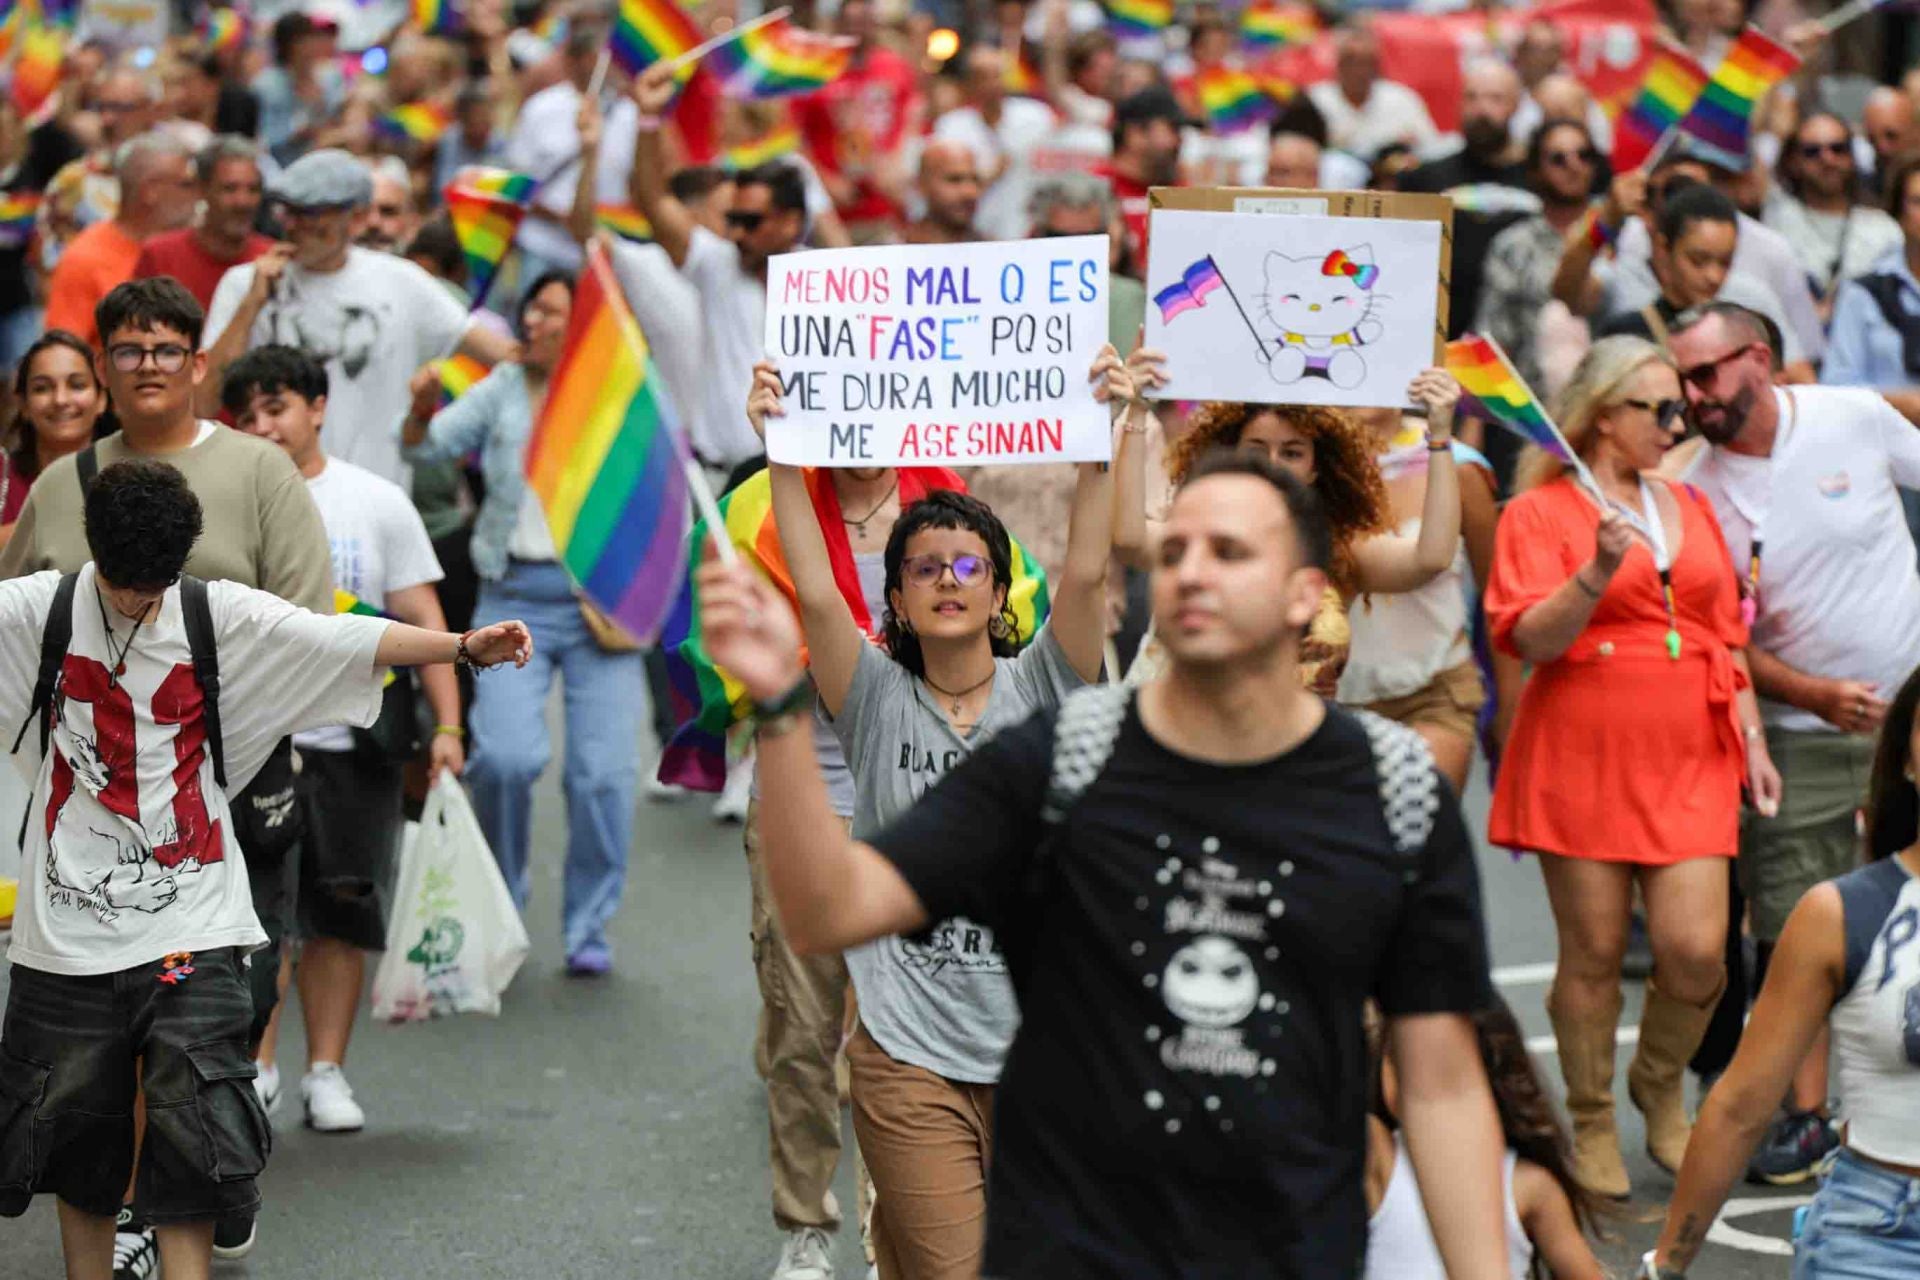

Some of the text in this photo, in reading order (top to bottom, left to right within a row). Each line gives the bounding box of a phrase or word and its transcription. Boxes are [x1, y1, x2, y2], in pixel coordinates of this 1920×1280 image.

[785, 266, 890, 304] MENOS
[906, 266, 981, 305] MAL
[1050, 260, 1098, 302] ES
[781, 314, 857, 357] UNA
[777, 365, 1066, 412] ME DURA MUCHO
[829, 418, 1064, 459] ME ASESINAN
[898, 742, 958, 773] BLAC
